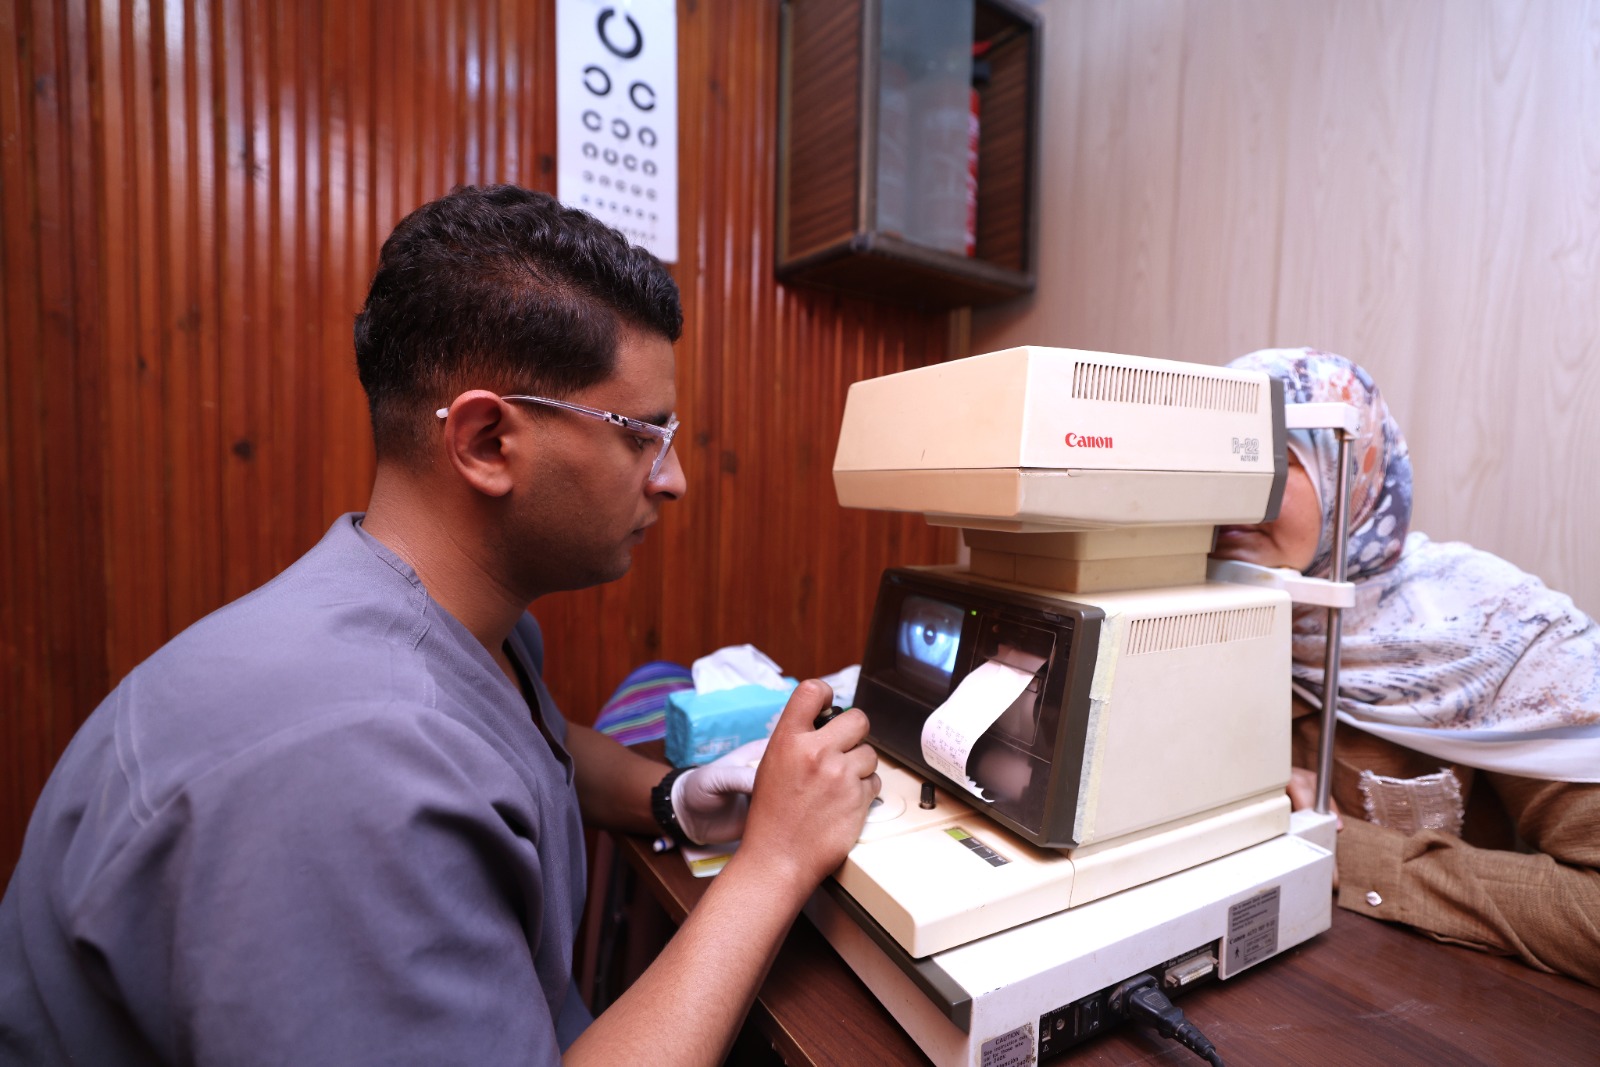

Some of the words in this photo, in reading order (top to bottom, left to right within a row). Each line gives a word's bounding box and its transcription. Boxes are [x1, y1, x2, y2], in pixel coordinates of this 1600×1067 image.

[1065, 432, 1113, 448] Canon
[1232, 437, 1259, 454] R-22
[995, 1031, 1020, 1045] CAUTION
